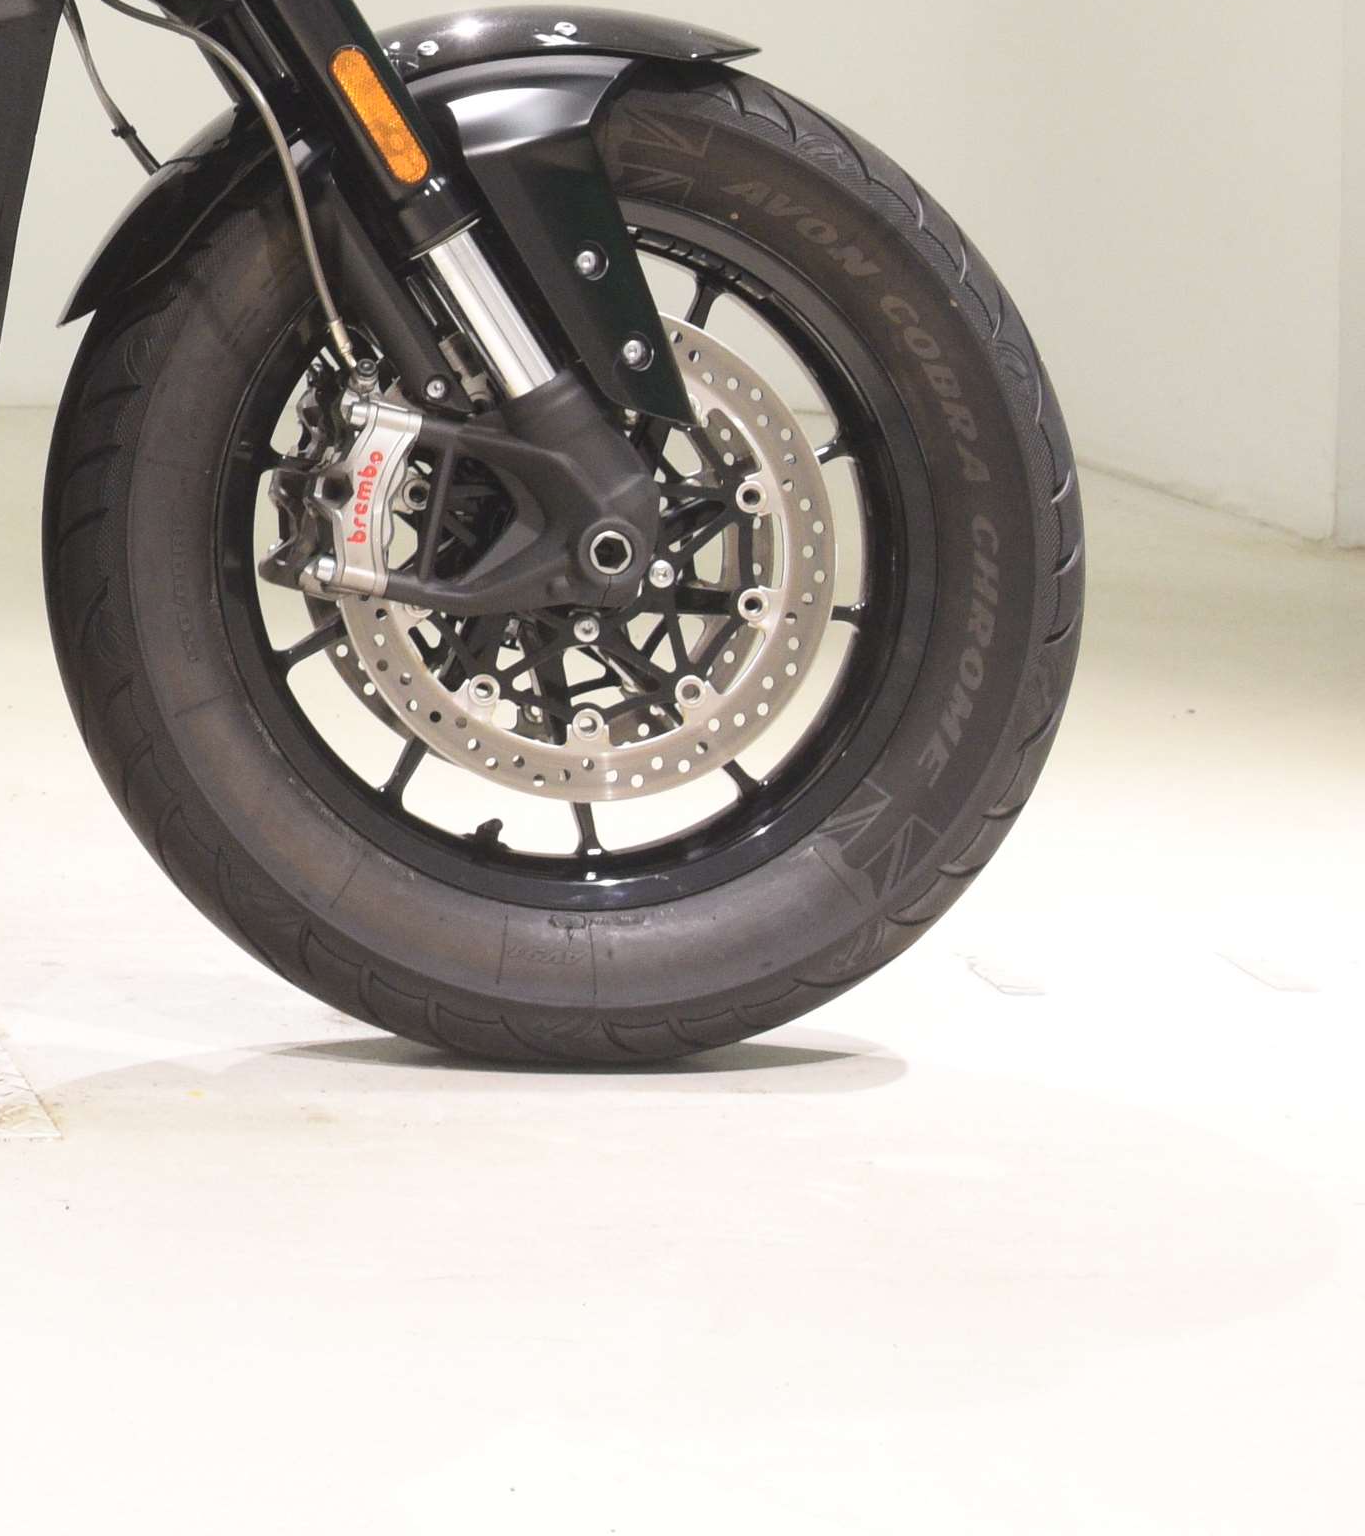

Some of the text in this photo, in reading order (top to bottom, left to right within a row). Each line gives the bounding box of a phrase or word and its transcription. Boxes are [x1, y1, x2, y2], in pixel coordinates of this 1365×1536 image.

[346, 450, 384, 545] brembo
[720, 180, 1001, 791] AVON COBRA CHROME
